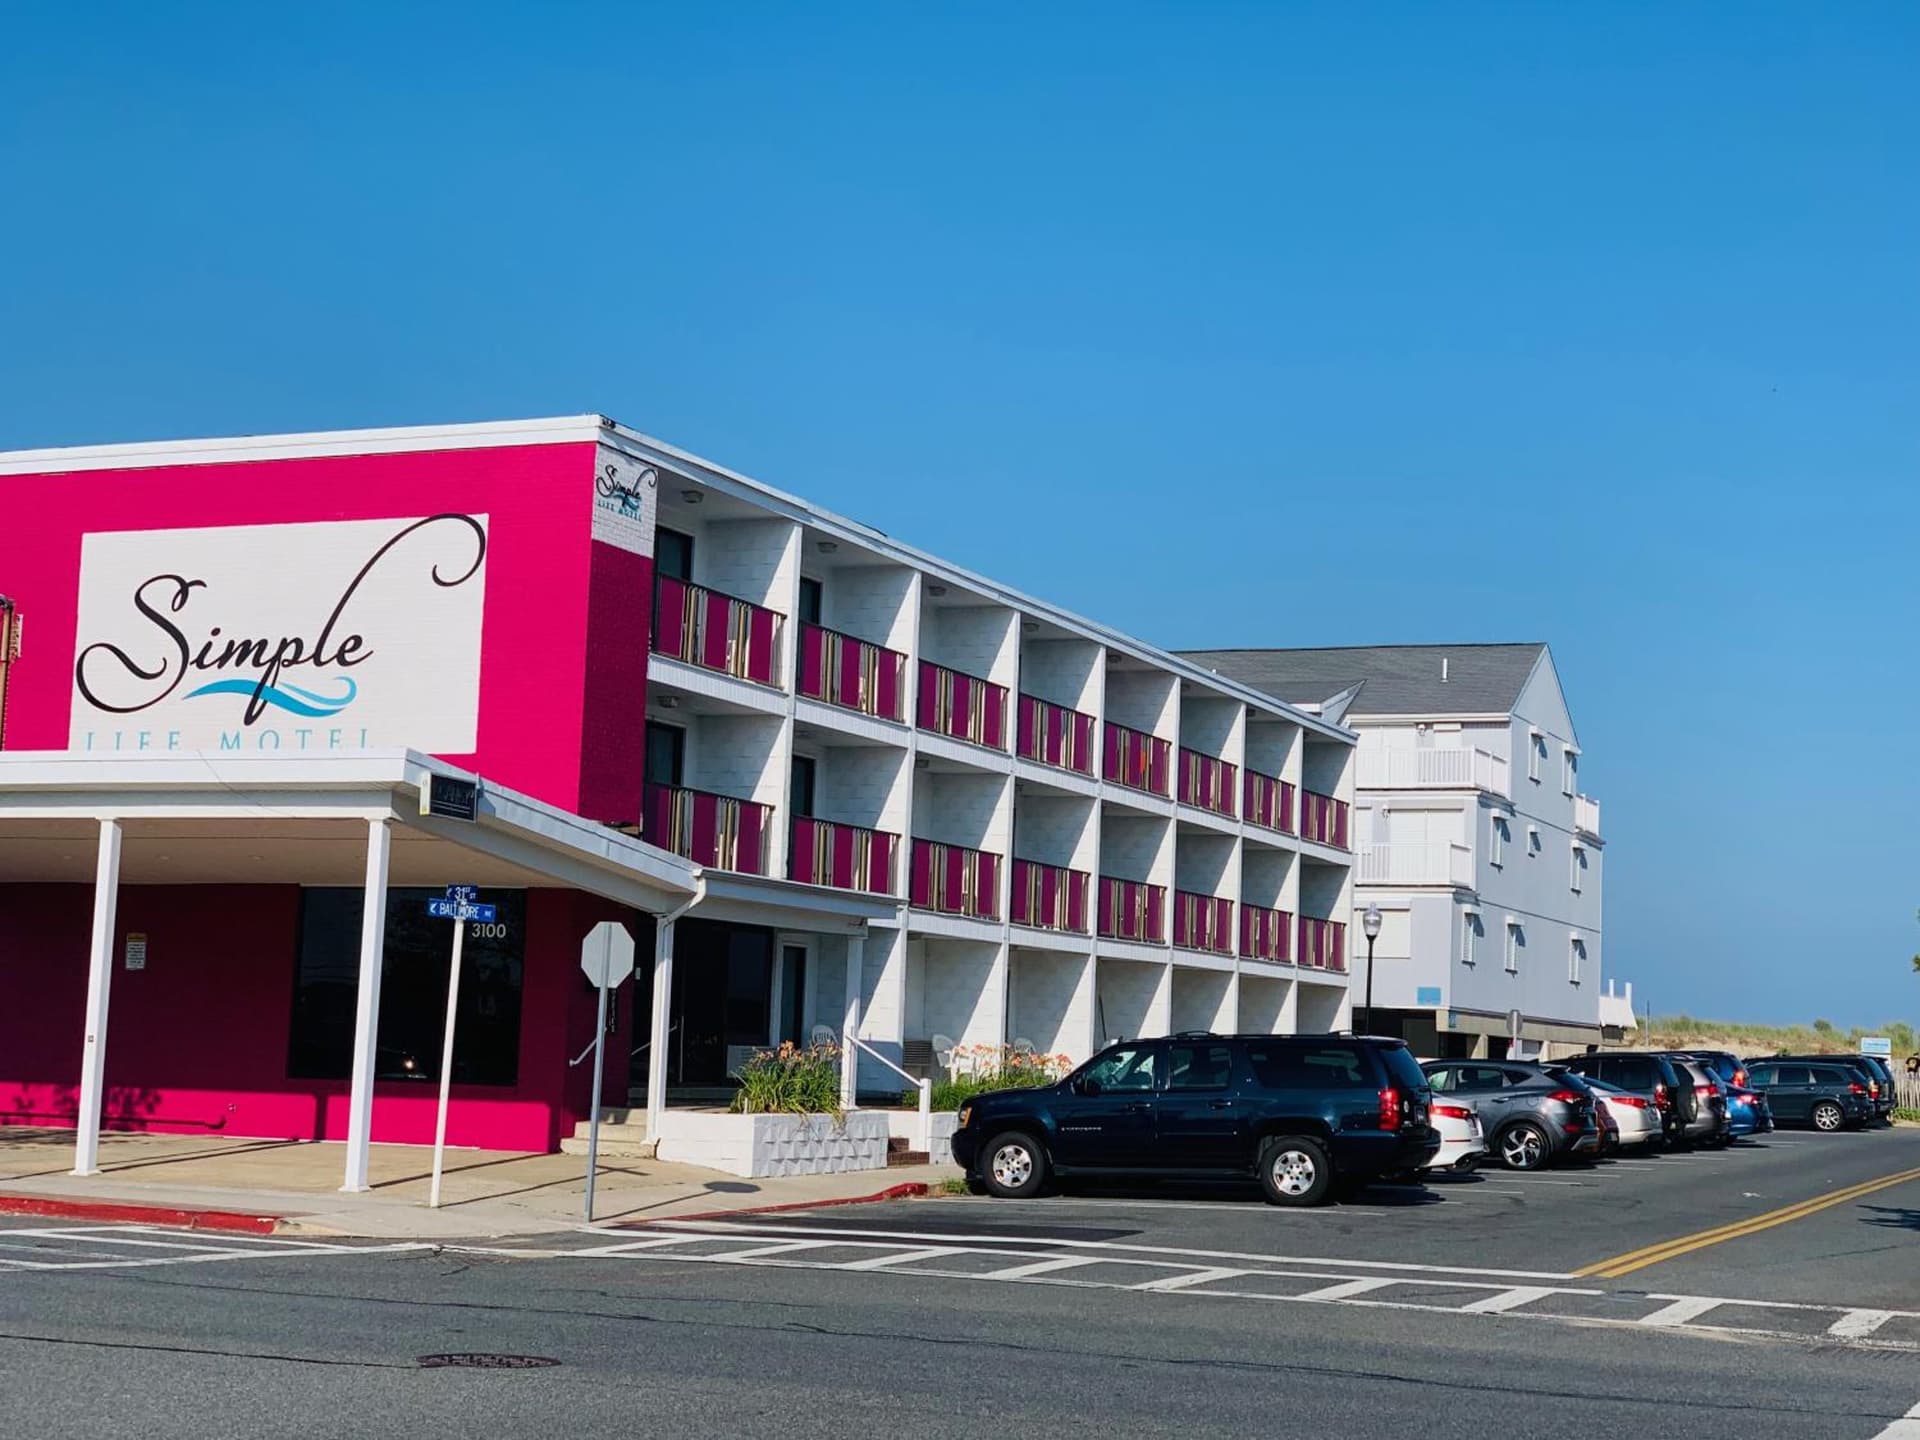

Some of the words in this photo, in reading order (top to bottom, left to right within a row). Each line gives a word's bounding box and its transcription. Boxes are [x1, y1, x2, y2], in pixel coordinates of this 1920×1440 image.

[596, 464, 657, 508] Simple
[76, 513, 486, 727] Simple
[440, 902, 480, 919] BALTMORE
[472, 923, 507, 938] 3100
